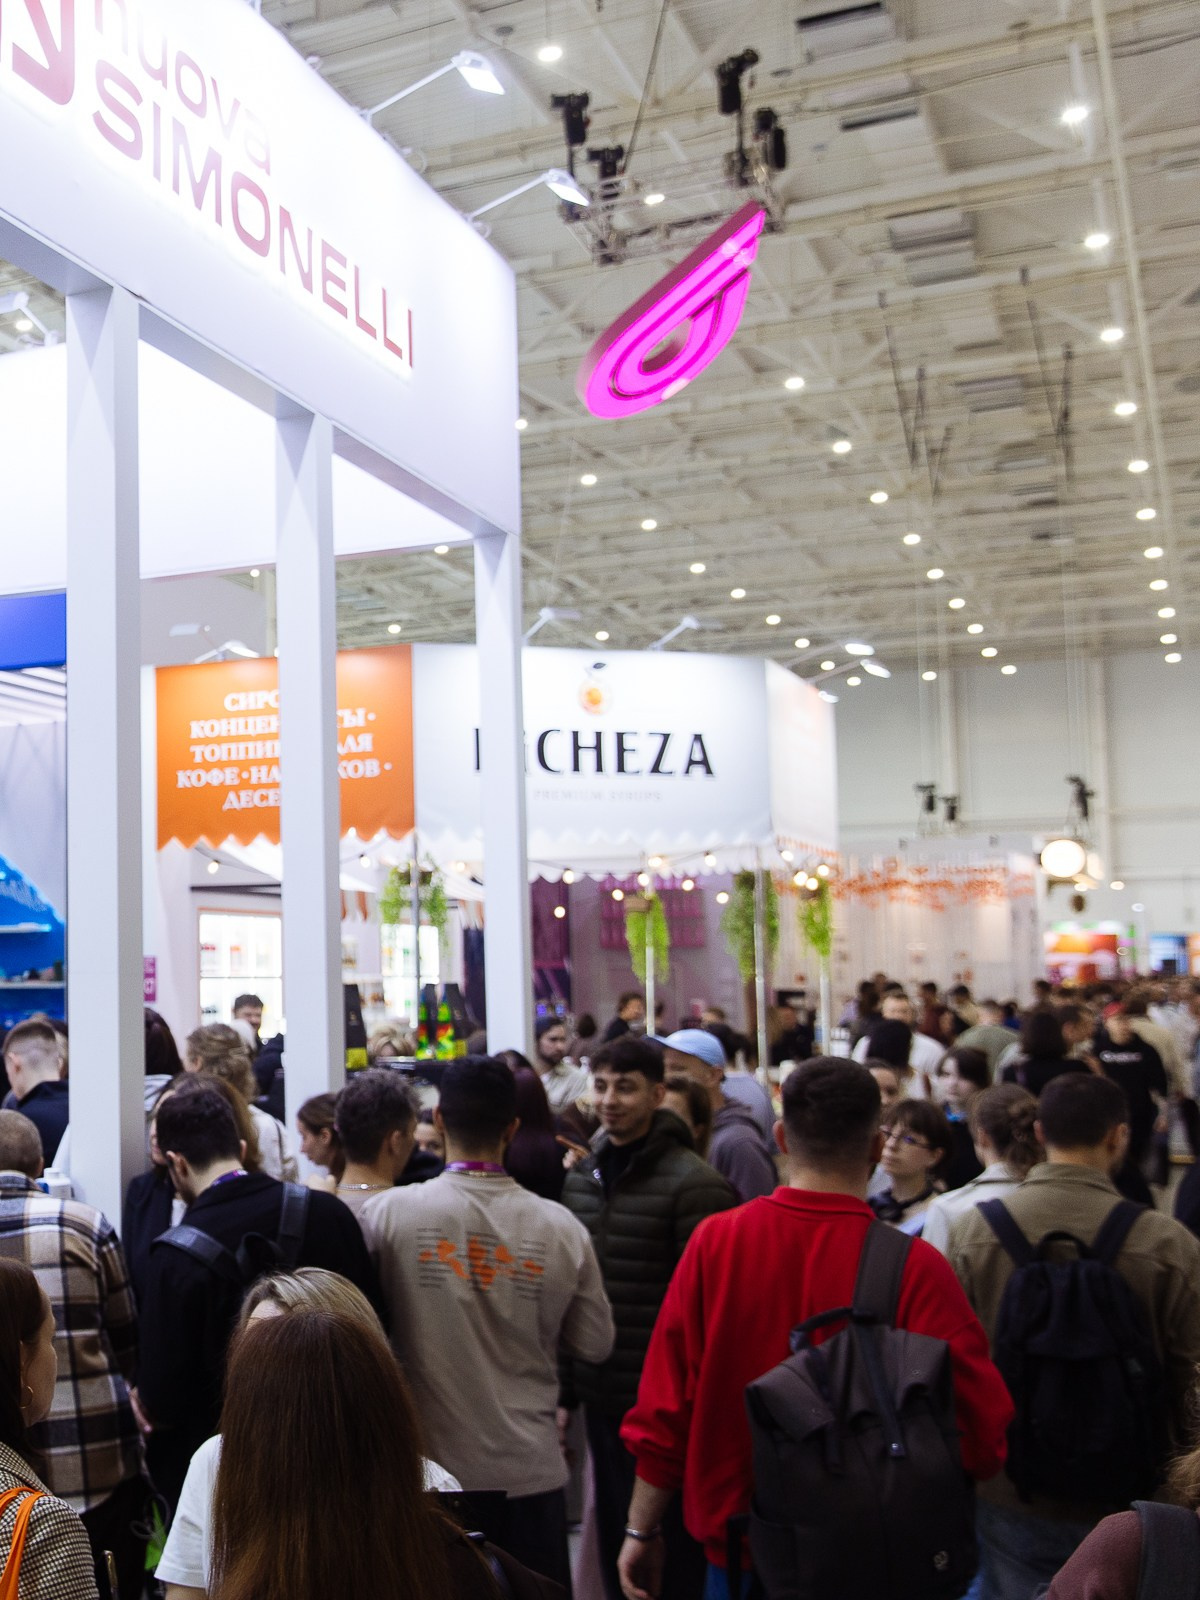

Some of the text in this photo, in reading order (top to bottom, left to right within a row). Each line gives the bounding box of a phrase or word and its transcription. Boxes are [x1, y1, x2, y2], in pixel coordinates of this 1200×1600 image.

[94, 0, 272, 177] nuova
[92, 59, 414, 368] SIMONELLI
[223, 690, 280, 712] СИРО
[474, 728, 715, 777] CHEZA
[222, 788, 280, 812] ДЕСЕ
